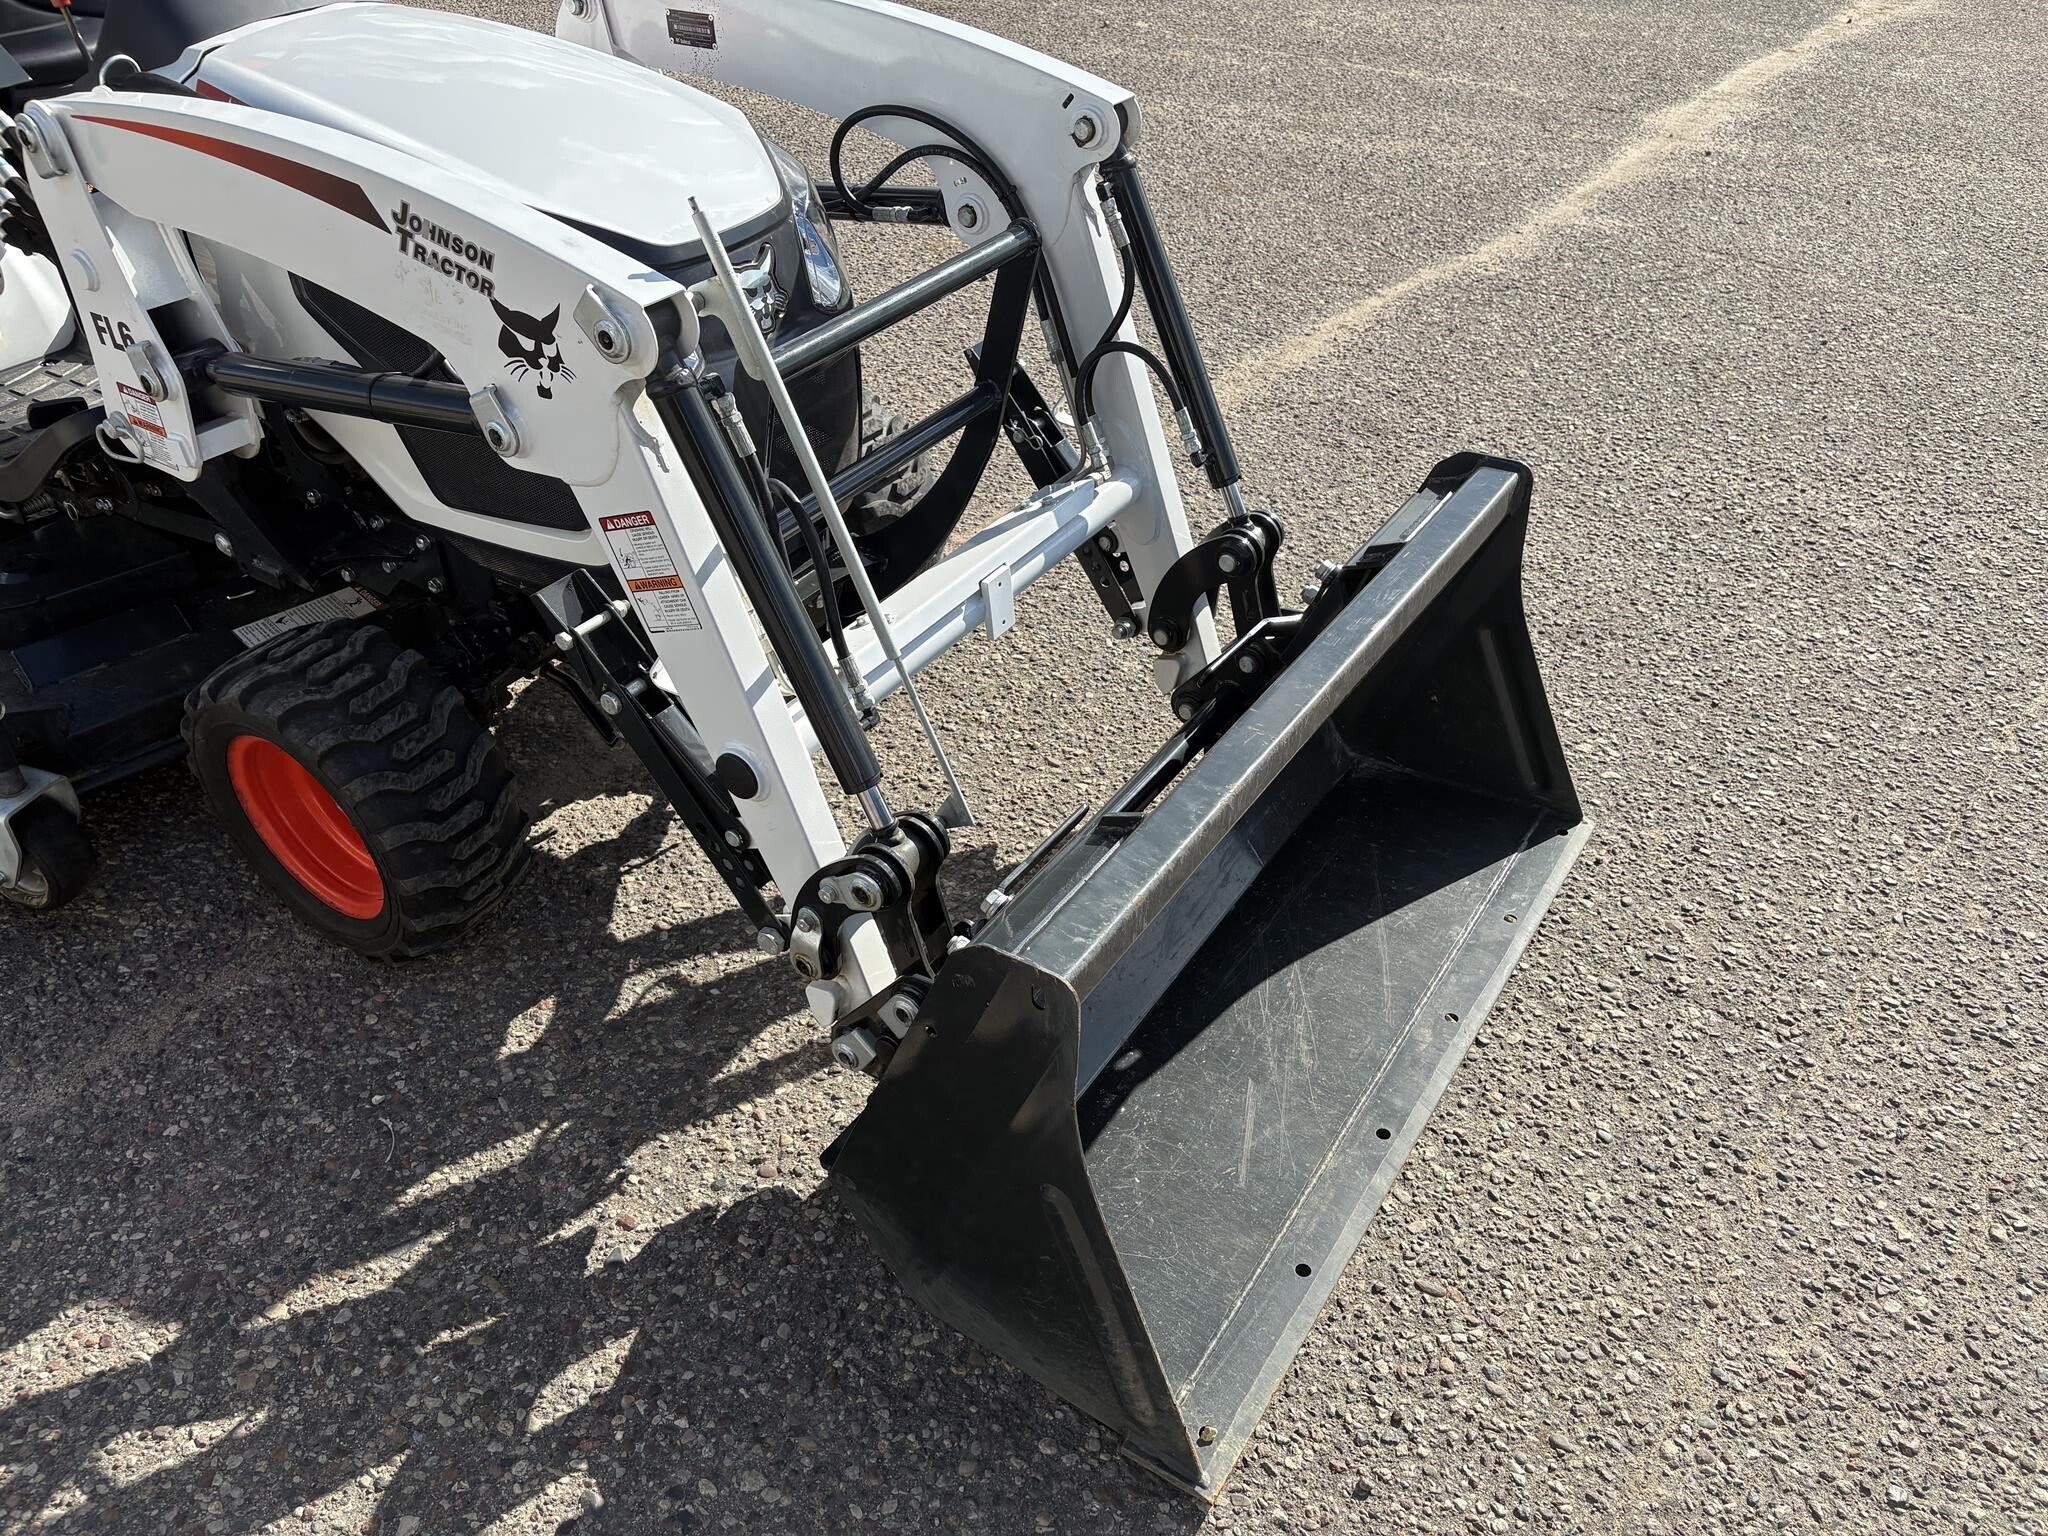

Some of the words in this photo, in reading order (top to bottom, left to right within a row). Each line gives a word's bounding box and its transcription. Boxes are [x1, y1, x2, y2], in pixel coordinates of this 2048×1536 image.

[391, 199, 495, 273] JOHNSON
[395, 225, 495, 298] TRACTOR
[89, 311, 136, 352] FL6
[614, 514, 650, 528] DANGER
[640, 578, 677, 590] WARNING
